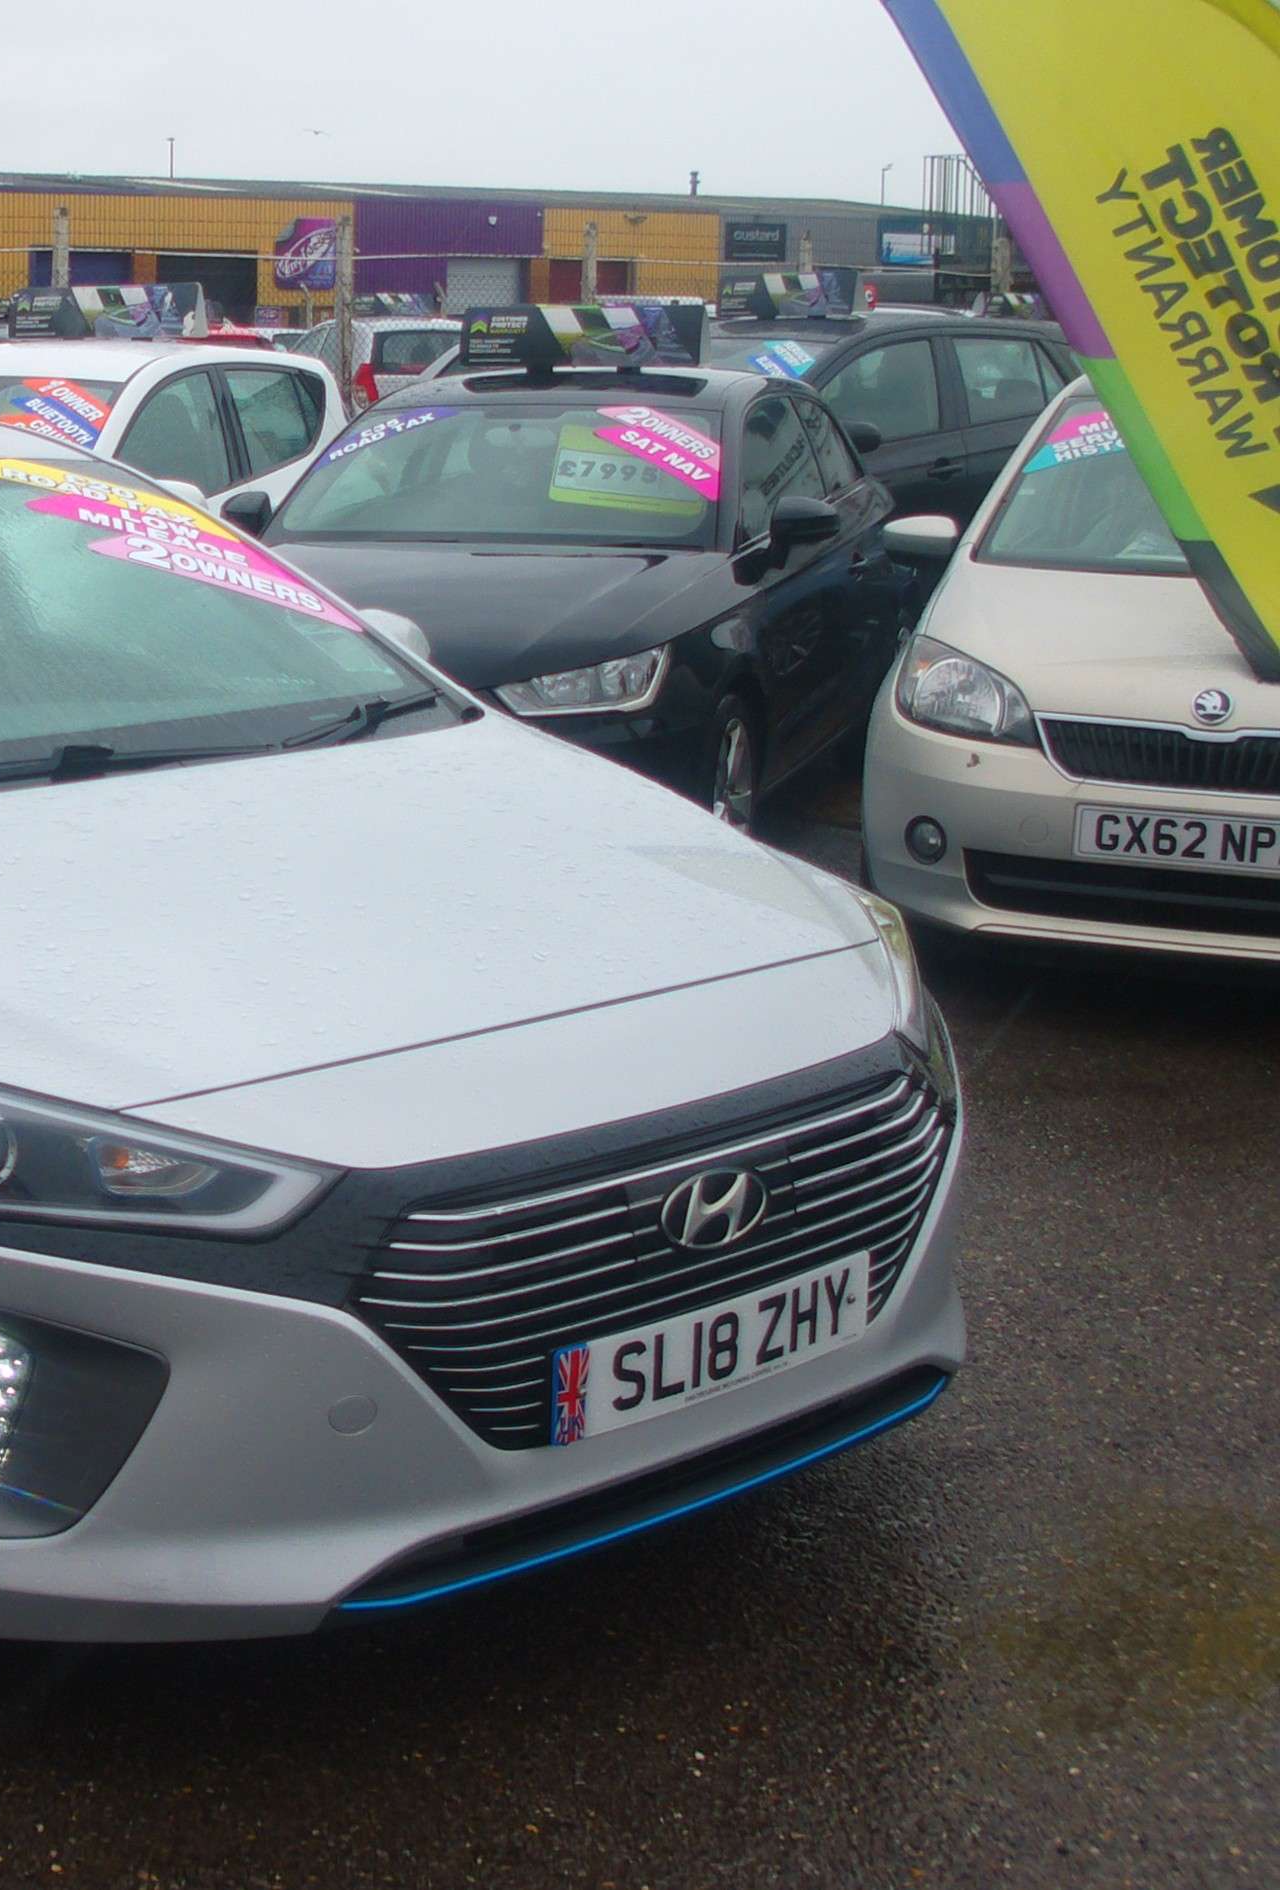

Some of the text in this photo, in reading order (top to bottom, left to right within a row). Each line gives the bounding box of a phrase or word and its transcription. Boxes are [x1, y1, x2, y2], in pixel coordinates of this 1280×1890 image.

[25, 398, 95, 445] BLUETOOTH
[51, 387, 105, 422] OWNER
[329, 412, 435, 461] ROAD TAX
[620, 407, 715, 460] 2 OWNERS
[620, 430, 712, 482] SAT NAV
[1, 466, 196, 528] ROAD TAX
[558, 460, 659, 484] £7995
[77, 507, 249, 568] MILEAGE
[120, 508, 200, 540] LOW
[126, 536, 325, 613] 2 OWNERS
[1095, 813, 1280, 864] GX62 NP
[611, 1311, 740, 1412] SL18
[756, 1268, 850, 1366] ZHY
